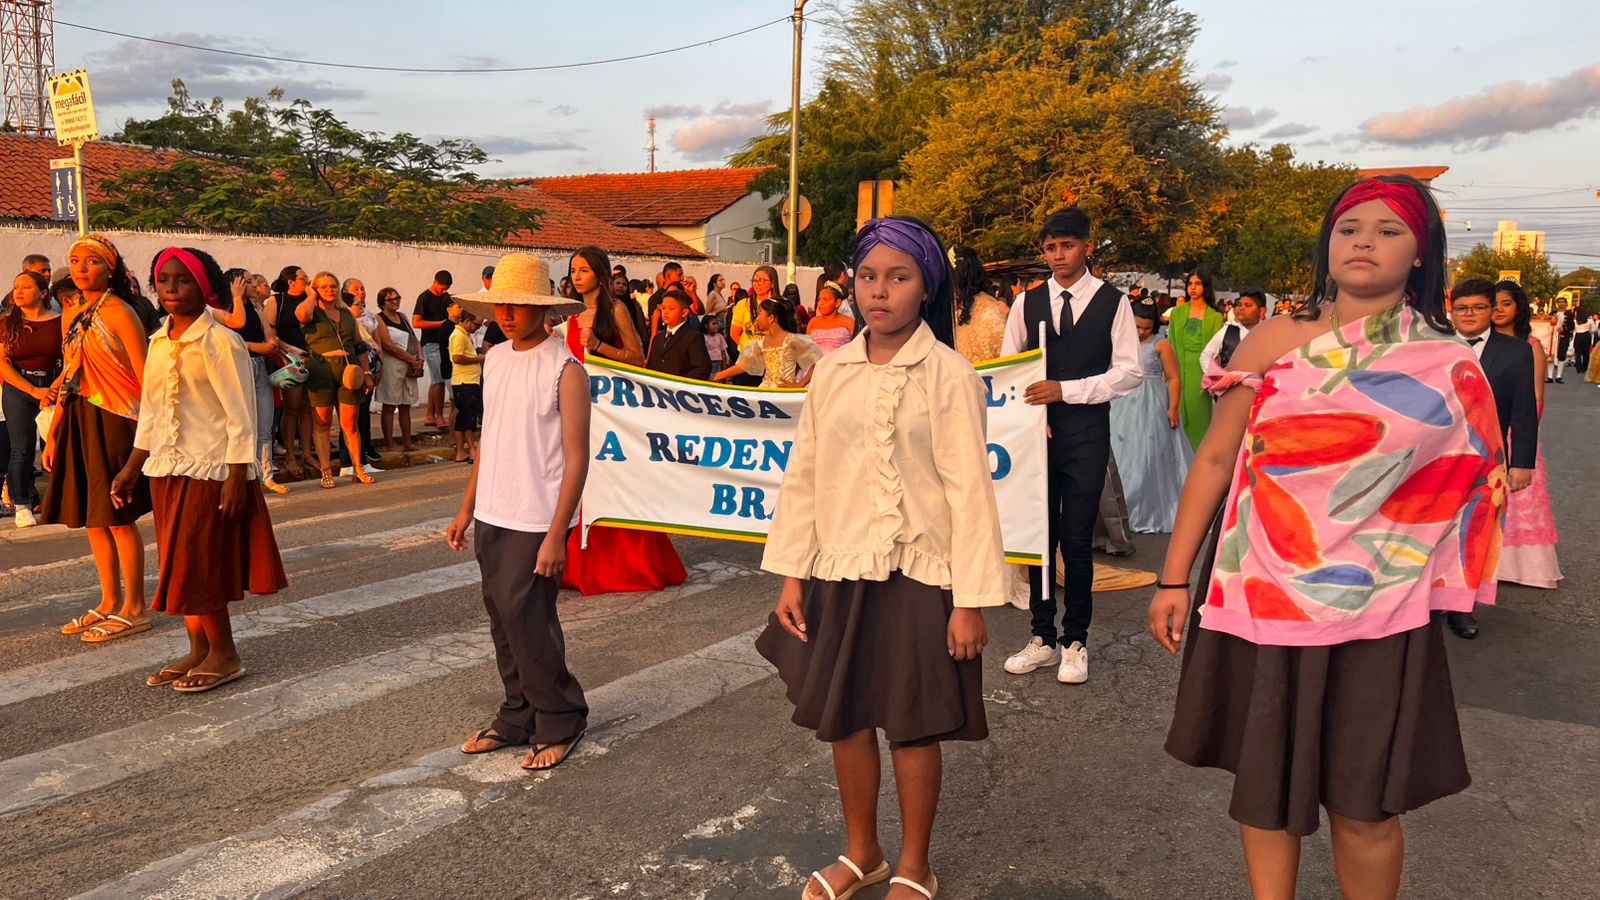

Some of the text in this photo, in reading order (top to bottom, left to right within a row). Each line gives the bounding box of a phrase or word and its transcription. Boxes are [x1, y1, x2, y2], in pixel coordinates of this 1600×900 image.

[55, 91, 87, 110] megafácil
[589, 375, 792, 420] PRINCESA
[596, 431, 627, 462] A
[646, 432, 793, 473] REDEN
[709, 483, 775, 520] BR
